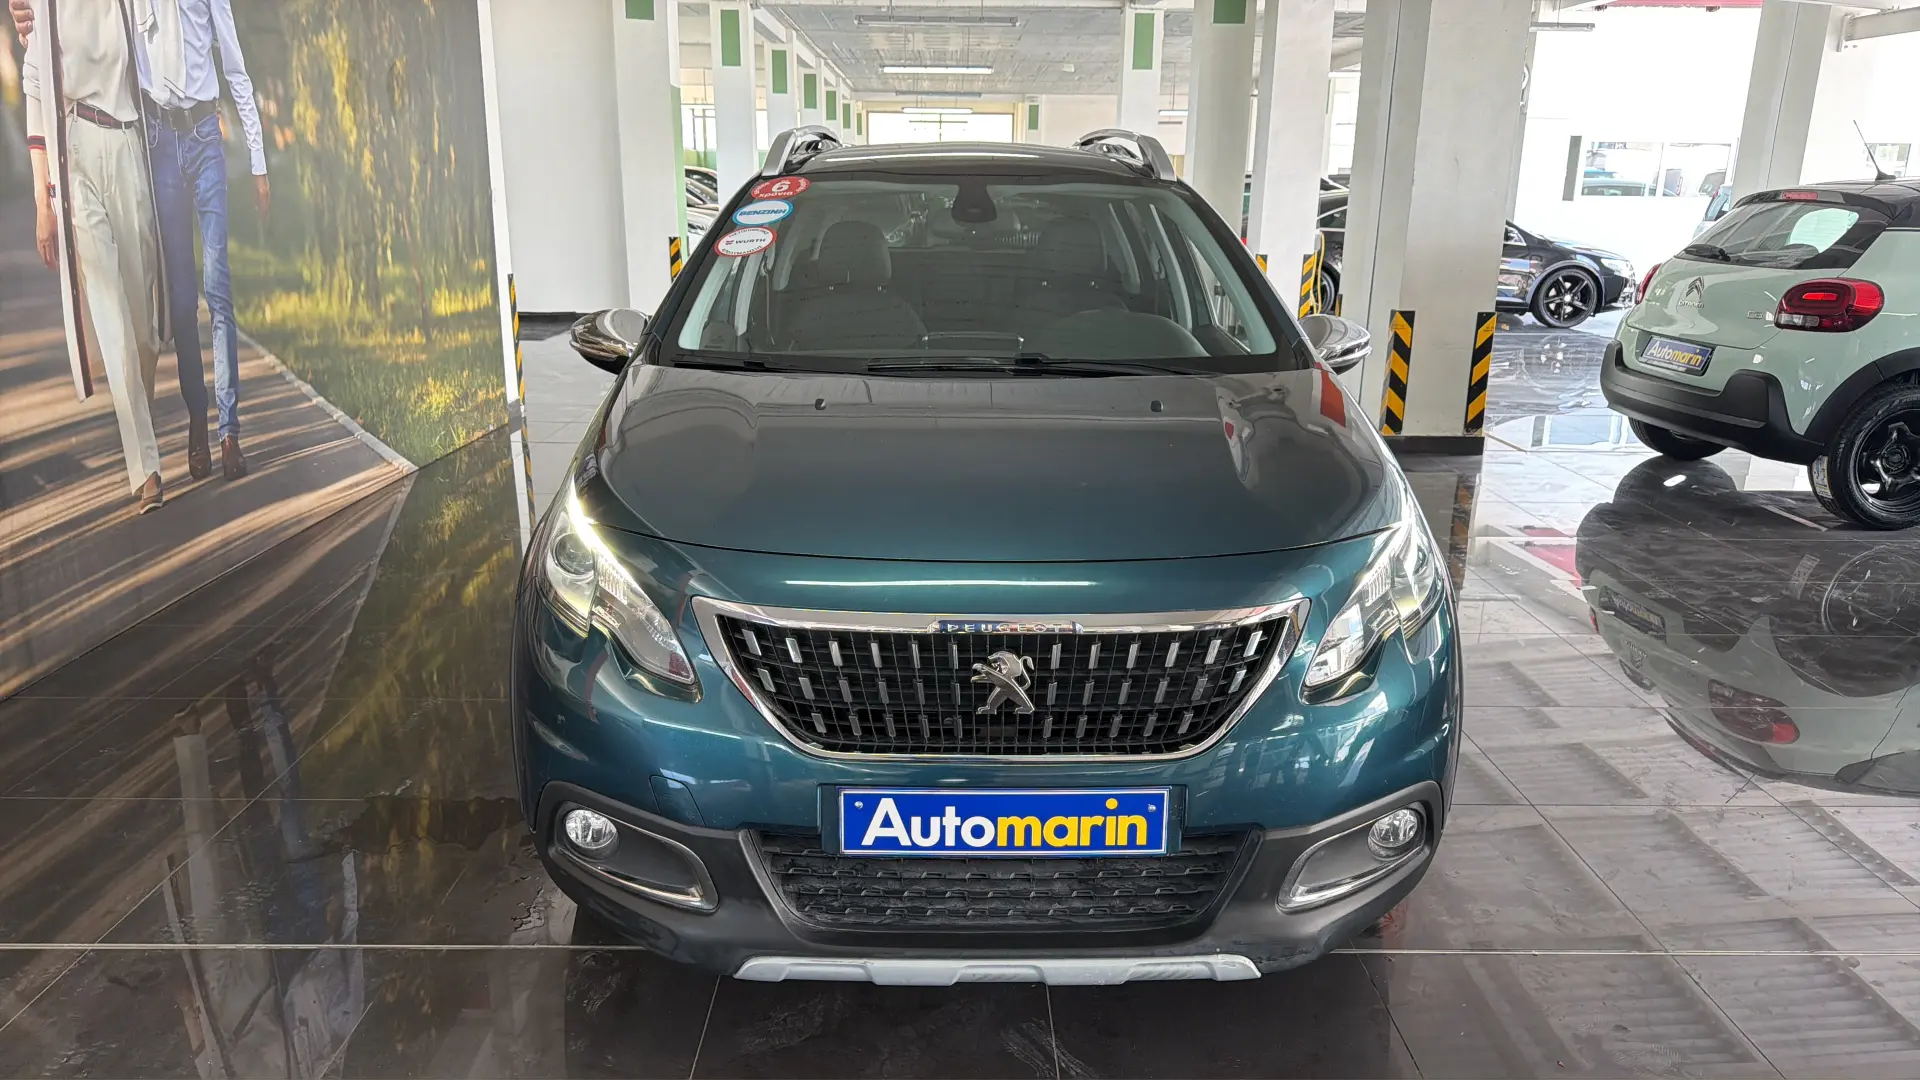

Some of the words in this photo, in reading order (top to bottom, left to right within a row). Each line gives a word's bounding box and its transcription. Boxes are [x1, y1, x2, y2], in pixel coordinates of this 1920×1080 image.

[772, 181, 791, 192] 6
[1647, 340, 1703, 367] Automarin
[946, 623, 1065, 633] PEUGEOT
[861, 797, 1147, 848] Automarin
